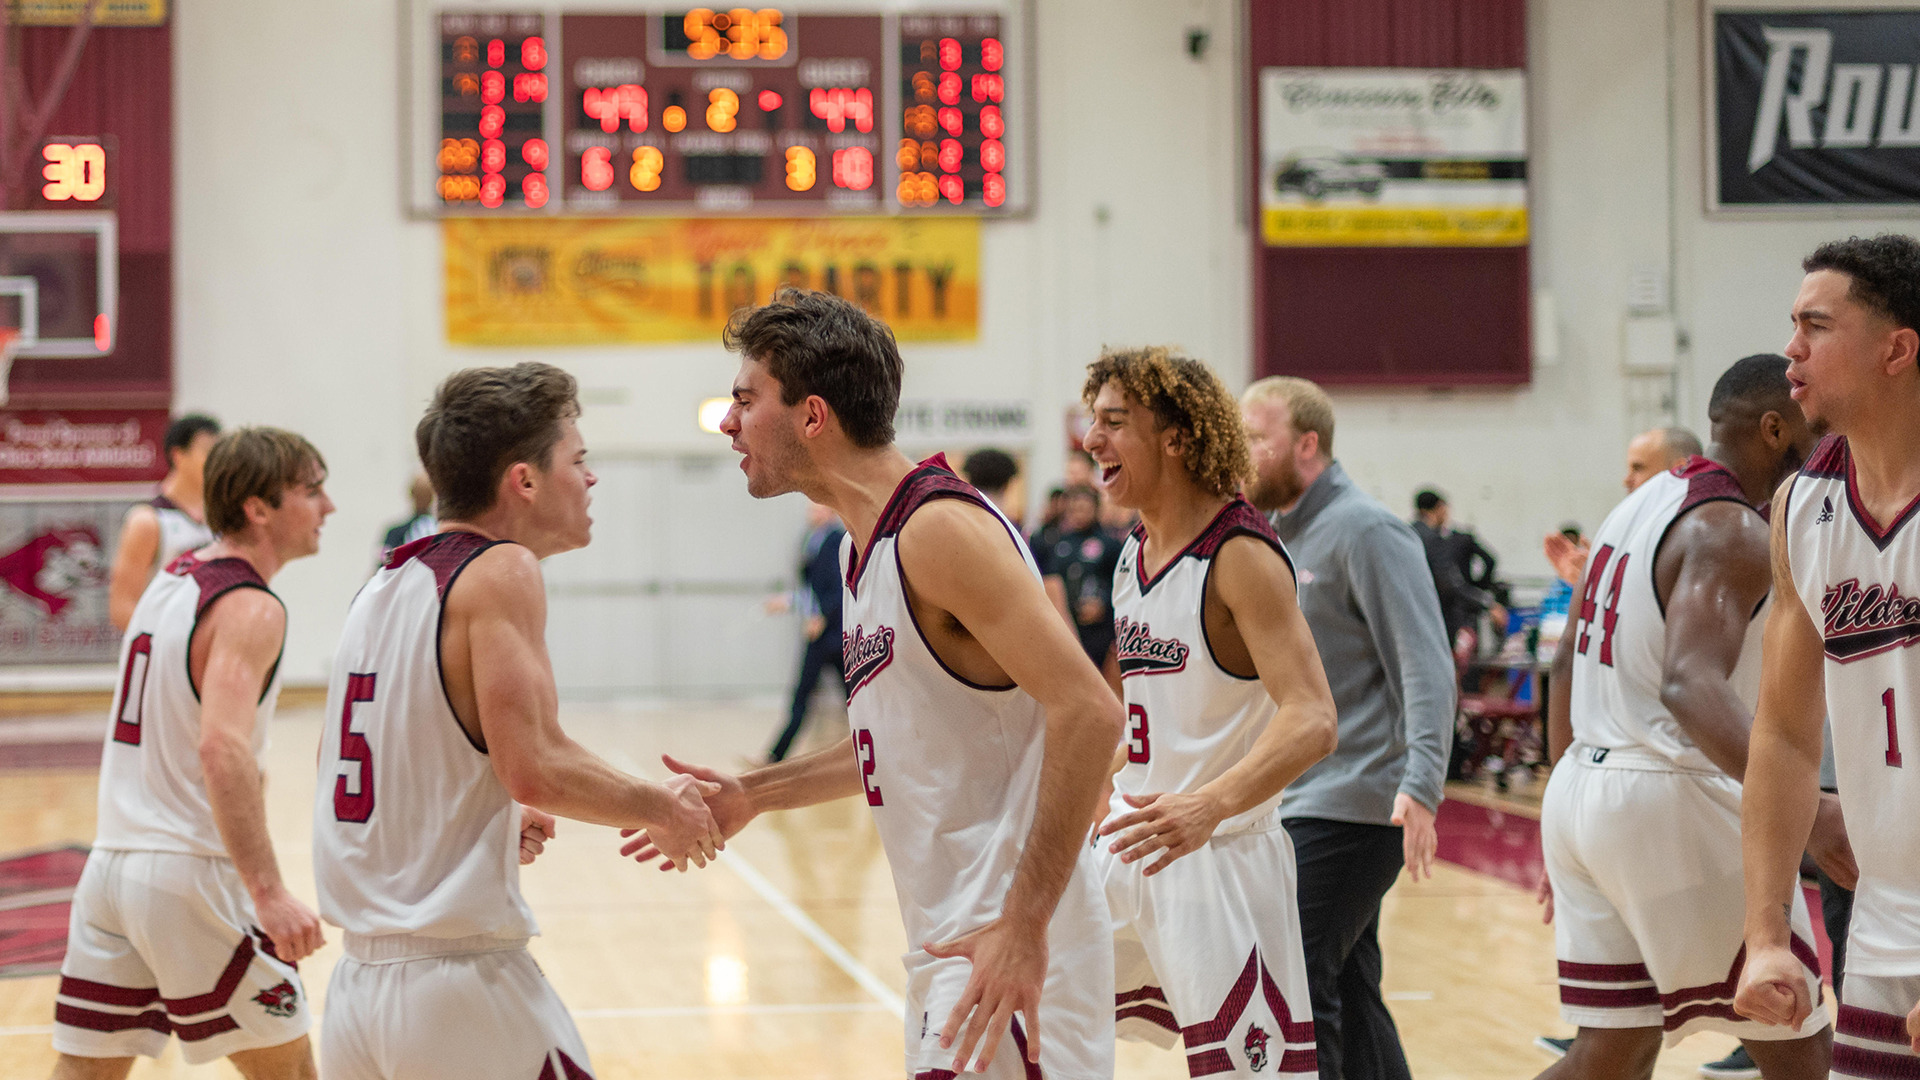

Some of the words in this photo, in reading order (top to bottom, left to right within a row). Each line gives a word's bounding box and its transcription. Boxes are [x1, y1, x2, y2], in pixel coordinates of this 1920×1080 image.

[683, 8, 788, 60] 5:35
[583, 84, 648, 133] 49
[810, 88, 873, 133] 44
[42, 143, 106, 201] 30
[581, 146, 614, 191] 6
[786, 146, 816, 191] 3
[1578, 543, 1630, 668] 44
[113, 632, 152, 747] 0
[334, 672, 377, 824] 5
[1128, 703, 1150, 764] 3
[1881, 687, 1903, 769] 1
